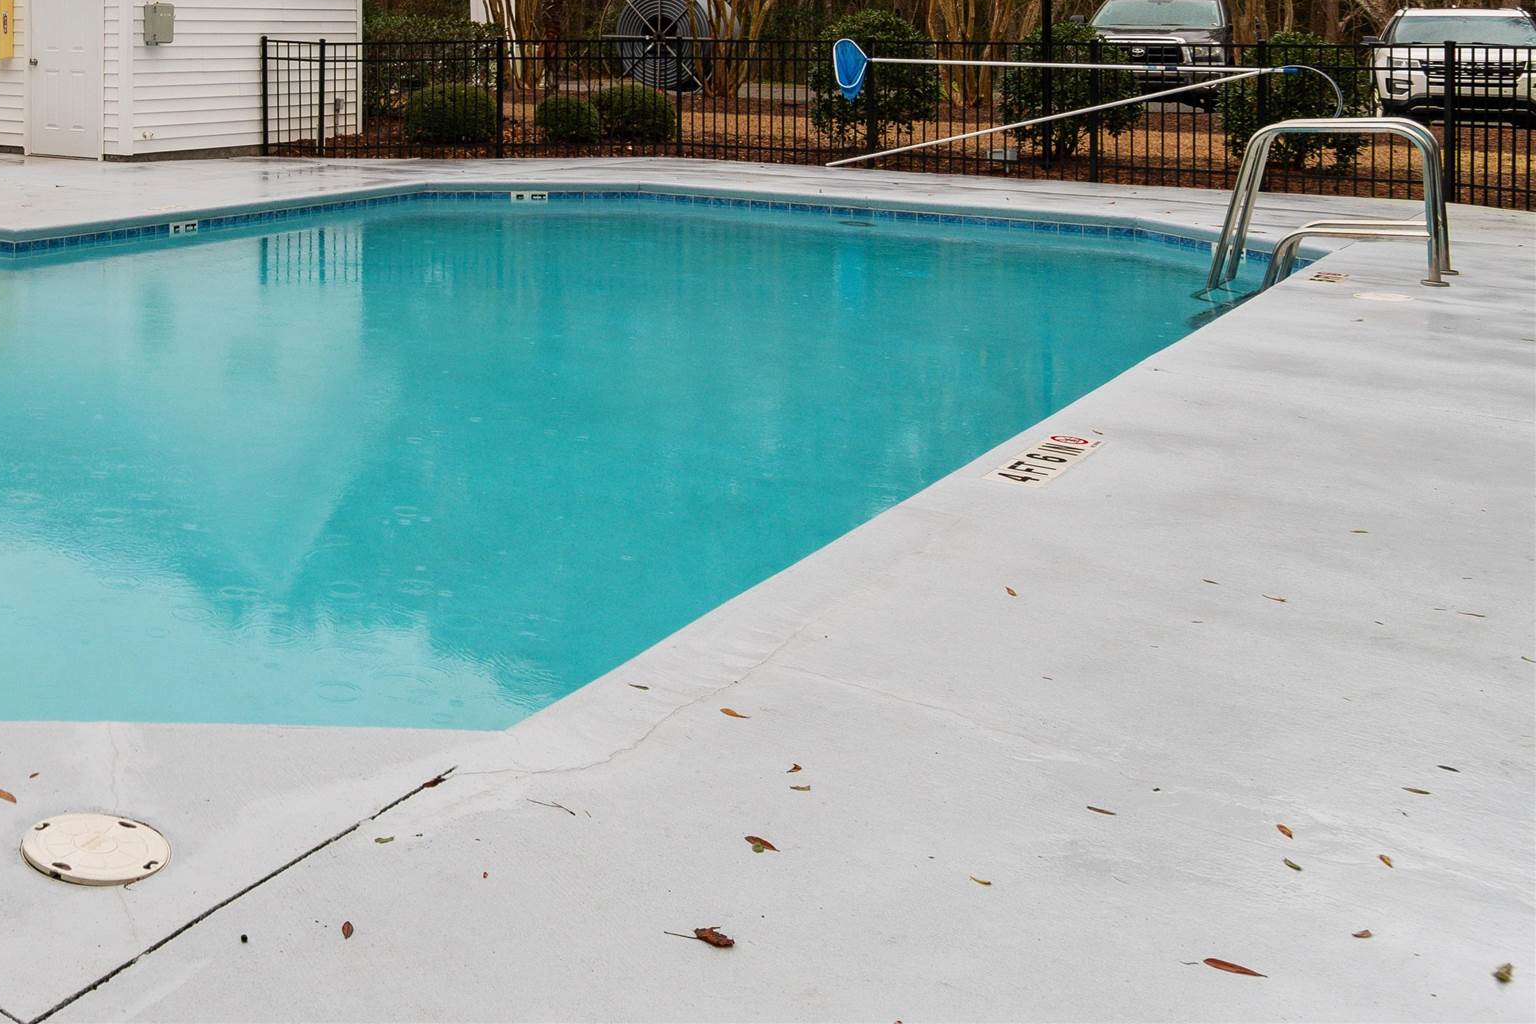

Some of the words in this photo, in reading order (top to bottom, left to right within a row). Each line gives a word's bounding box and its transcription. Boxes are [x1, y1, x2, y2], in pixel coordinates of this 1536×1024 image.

[1038, 442, 1085, 457] IN
[1025, 453, 1068, 464] 6
[1007, 460, 1057, 476] FT
[997, 472, 1040, 483] 4
